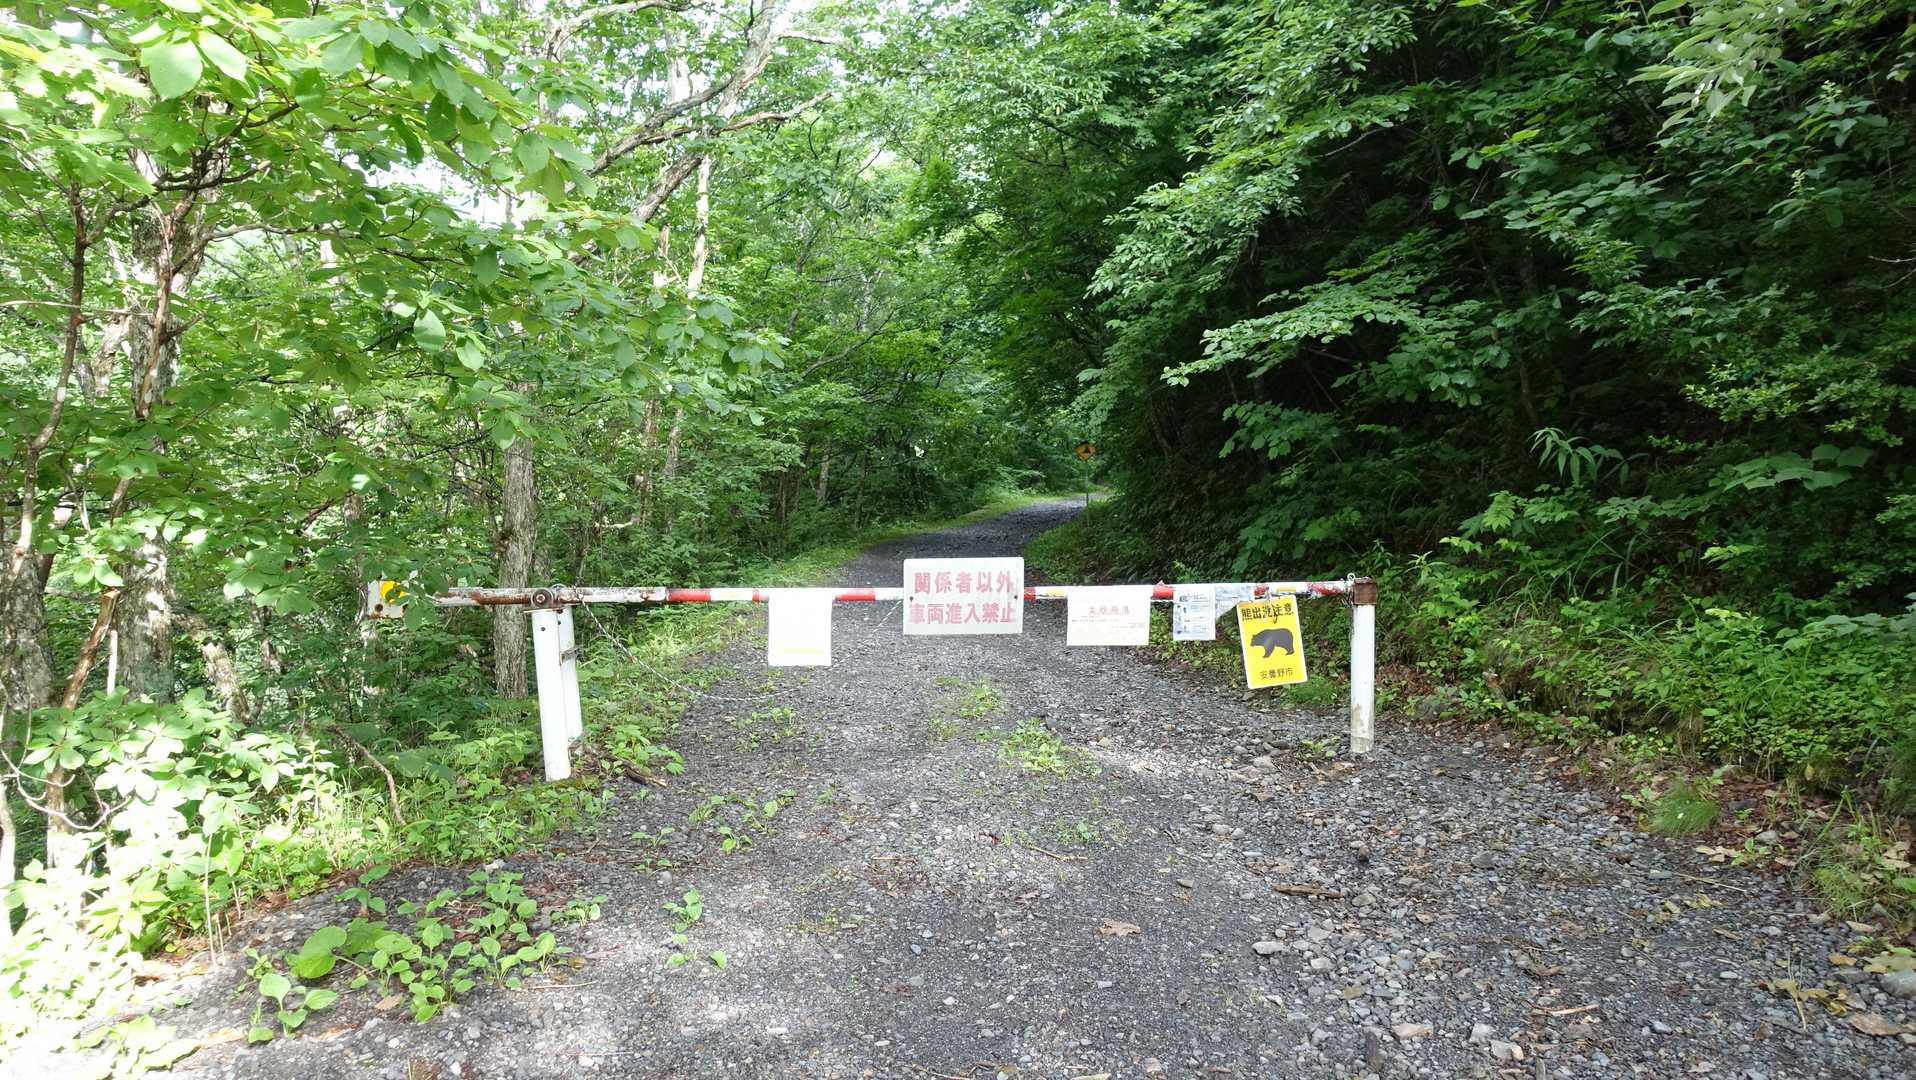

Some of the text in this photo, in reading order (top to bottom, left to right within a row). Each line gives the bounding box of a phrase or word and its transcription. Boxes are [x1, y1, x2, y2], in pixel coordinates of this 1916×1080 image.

[915, 570, 1014, 594] 関係者以外
[909, 602, 1018, 624] 車両進入禁止
[1241, 602, 1294, 621] 熊出没注意
[1260, 667, 1294, 680] 安曇野市
